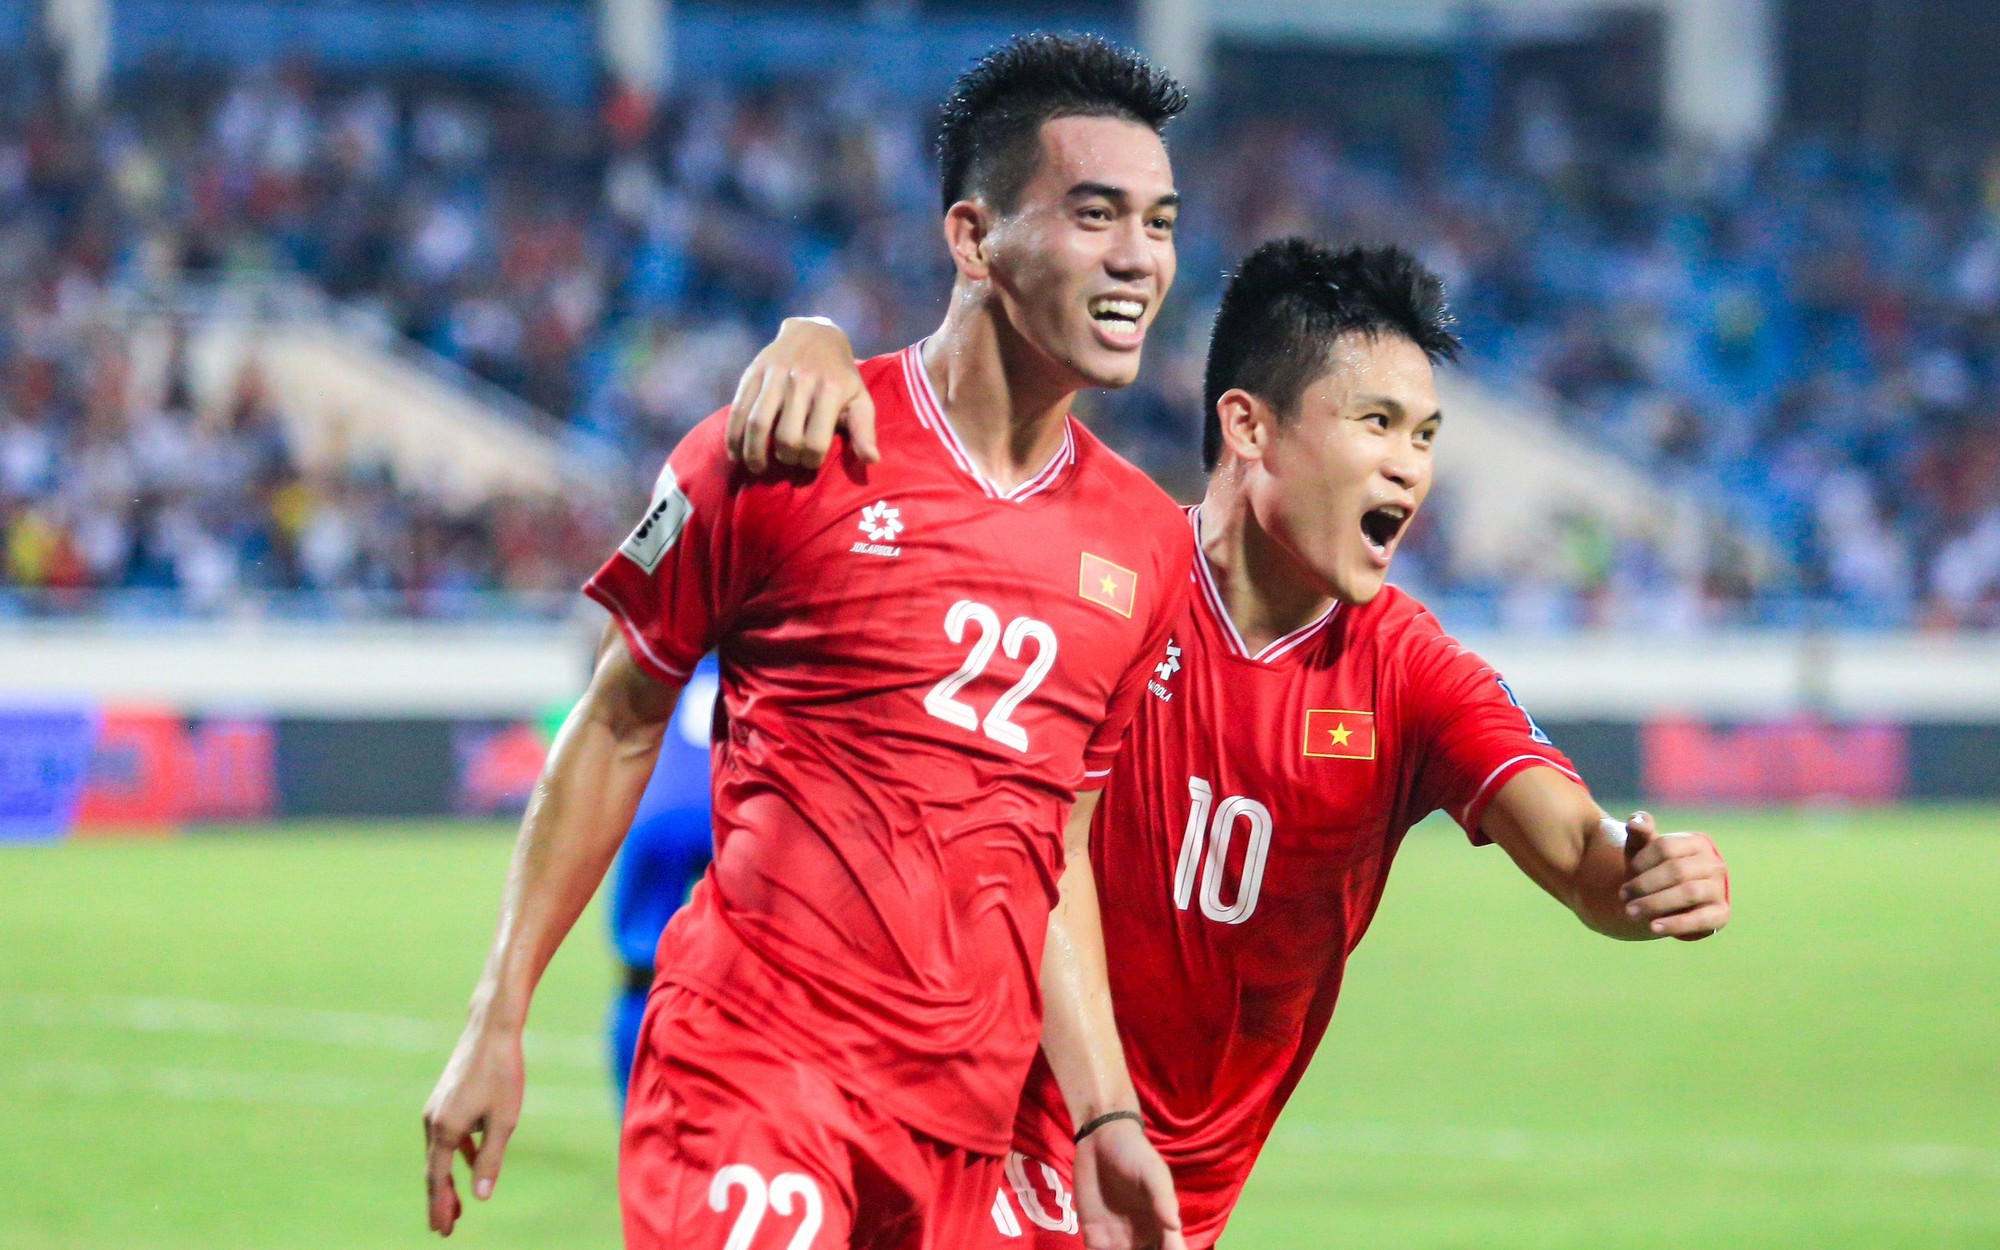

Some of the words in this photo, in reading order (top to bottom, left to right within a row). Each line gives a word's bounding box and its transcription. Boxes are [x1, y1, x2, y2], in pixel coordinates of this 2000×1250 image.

[923, 599, 1058, 753] 22
[1173, 775, 1273, 925] 10
[708, 1163, 824, 1250] 22
